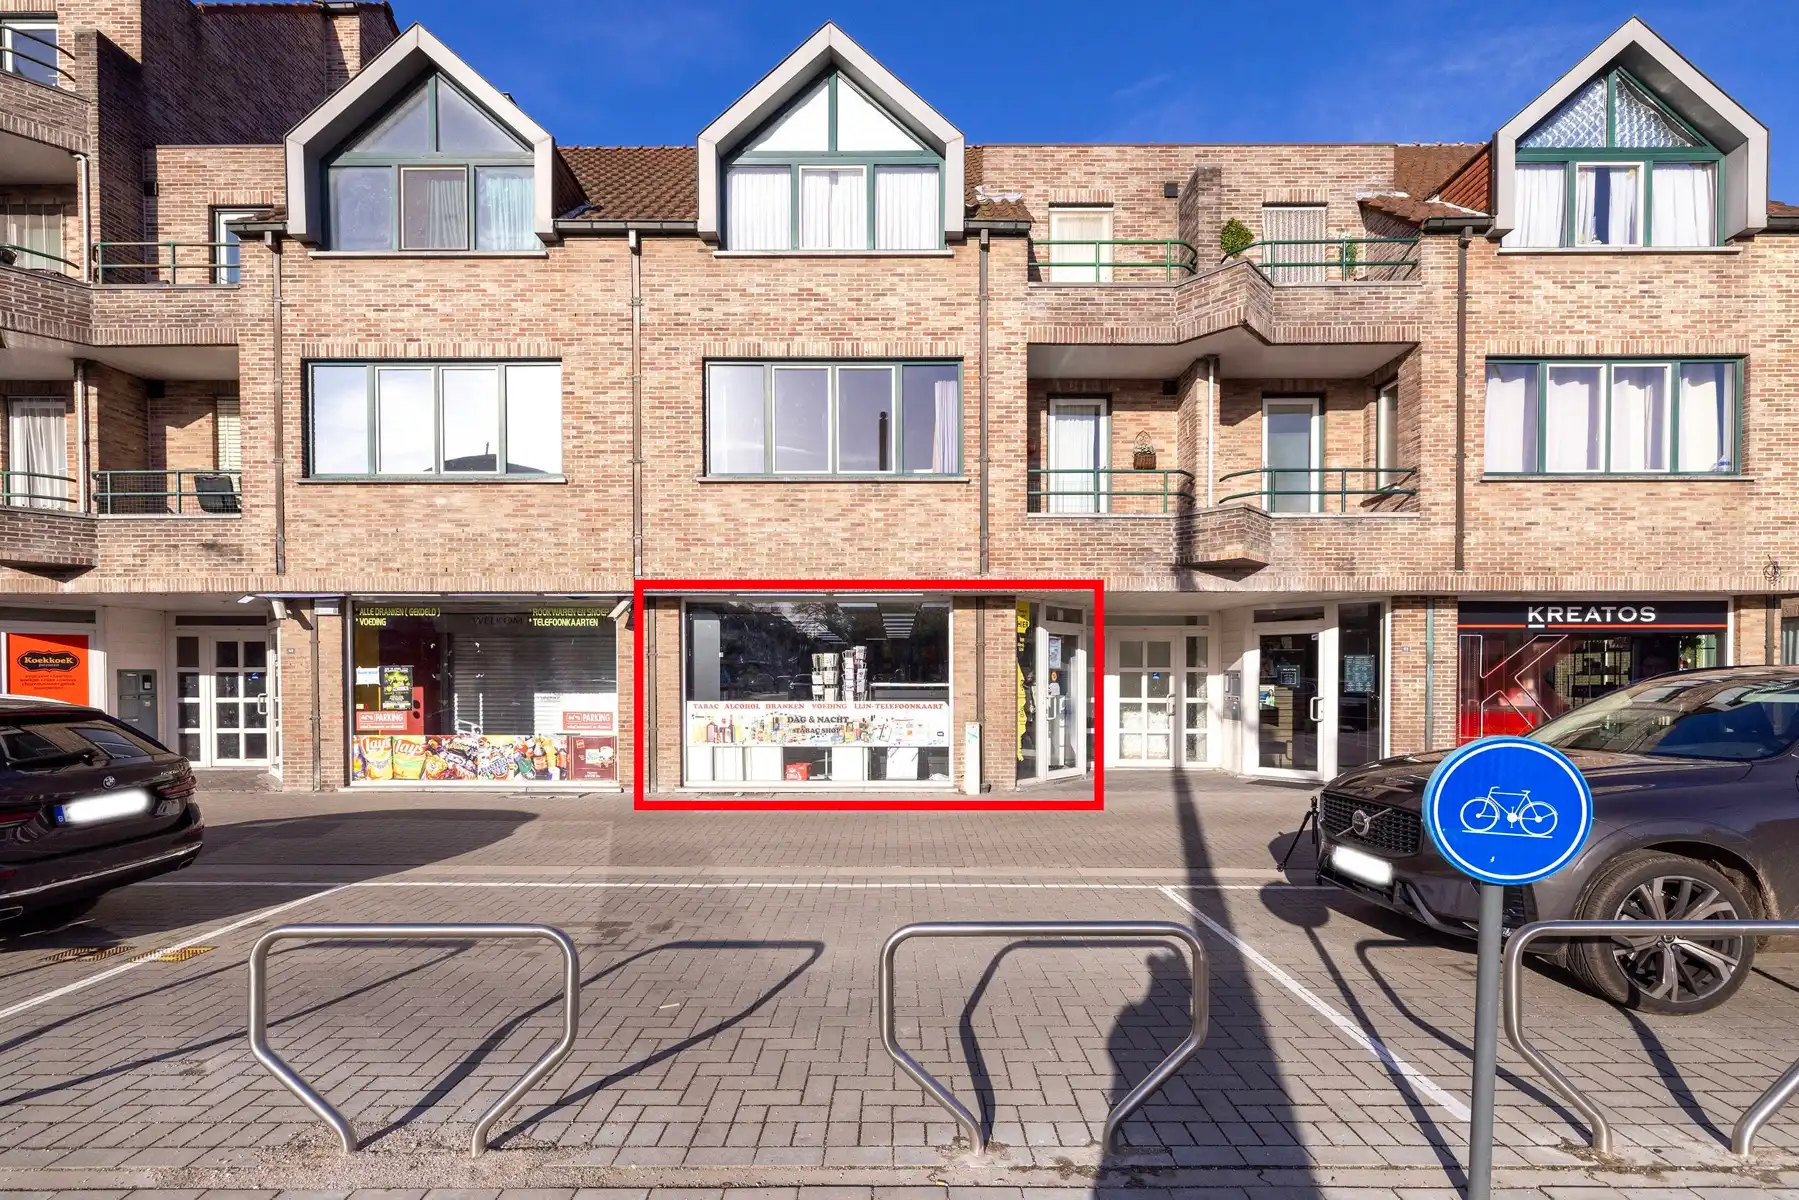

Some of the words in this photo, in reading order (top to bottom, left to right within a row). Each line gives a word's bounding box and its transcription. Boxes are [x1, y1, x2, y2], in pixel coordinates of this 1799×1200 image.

[359, 608, 374, 616] ALLE
[1527, 606, 1657, 623] KREATOS
[359, 617, 387, 626] VOEDING
[533, 618, 599, 627] TELEFOONKAARTEN
[582, 713, 610, 722] PARKING
[787, 716, 807, 724] DAG
[808, 716, 815, 724] &
[817, 716, 850, 724] NACHT
